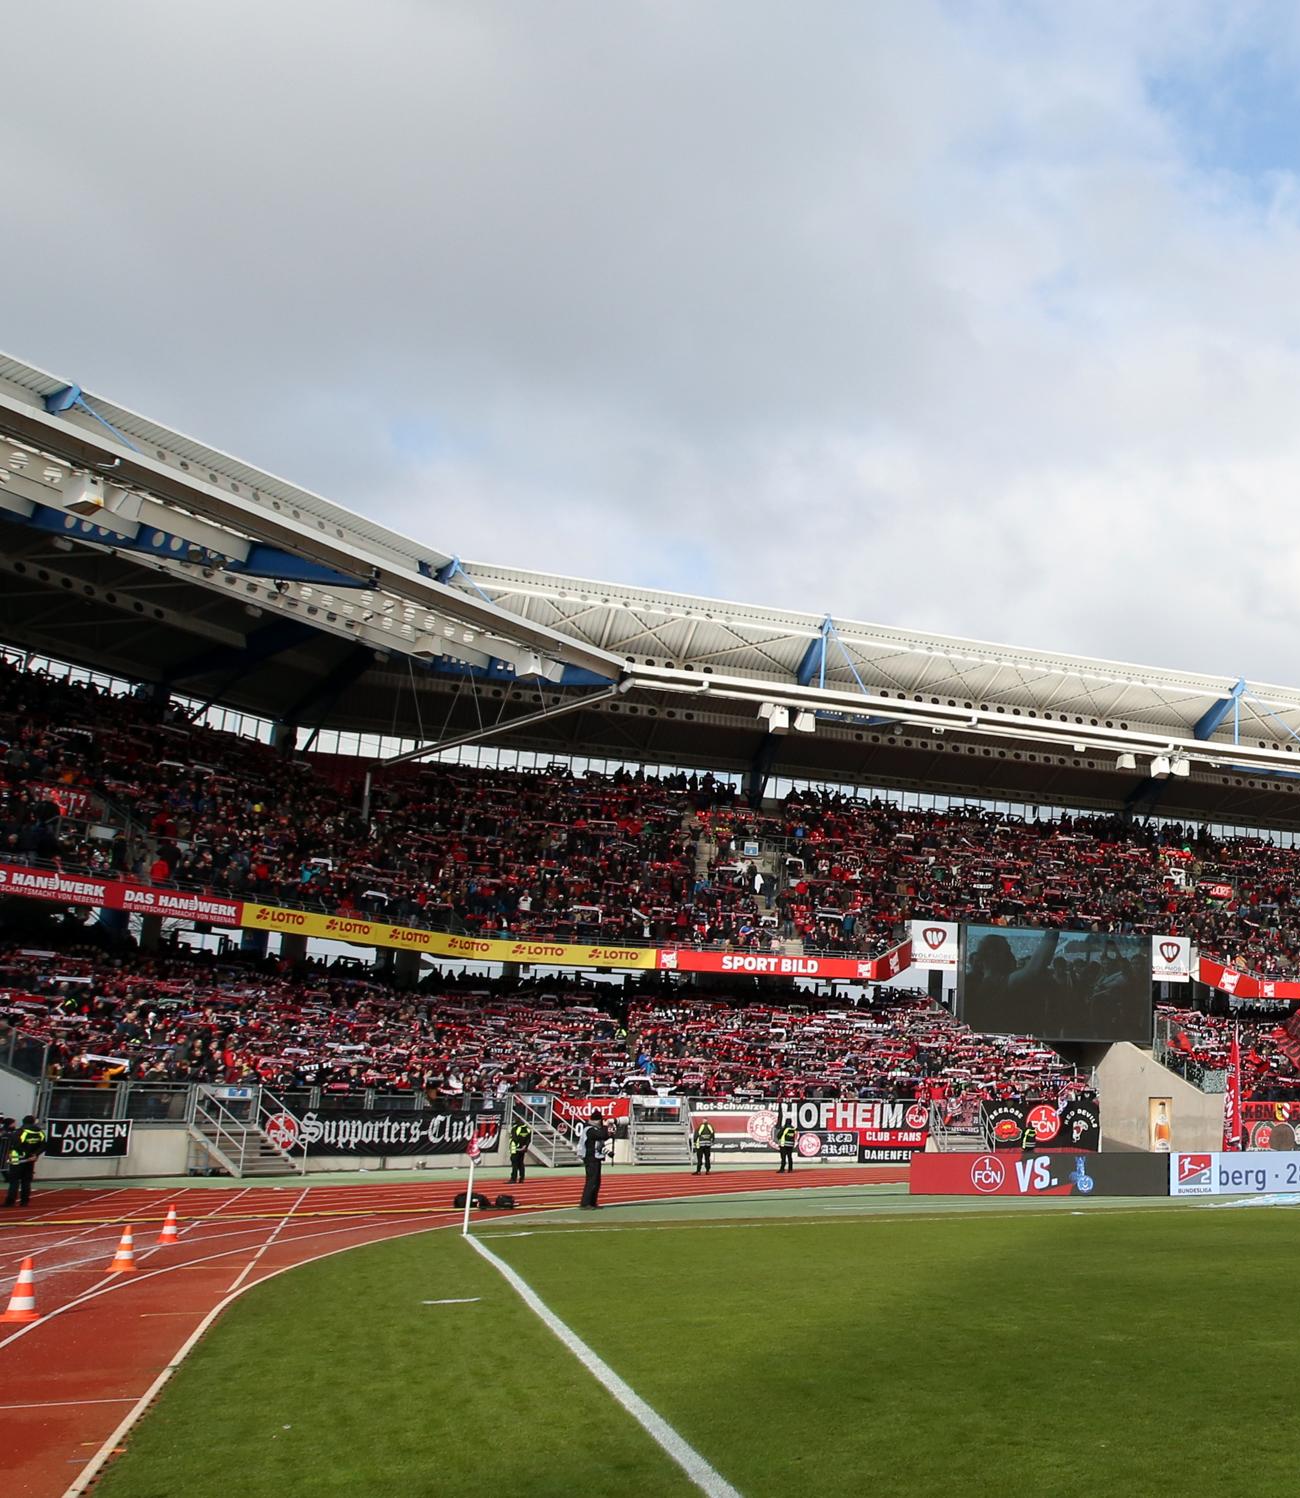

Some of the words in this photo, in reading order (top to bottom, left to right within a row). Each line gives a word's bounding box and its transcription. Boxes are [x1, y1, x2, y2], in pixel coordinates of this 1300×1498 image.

[124, 889, 155, 905] DAS
[158, 895, 237, 918] HANDWERK
[272, 912, 305, 926] LOTTO
[339, 921, 371, 935] LOTTO
[401, 931, 431, 944] LOTTO
[458, 940, 490, 952] LOTTO
[528, 945, 564, 957] LOTTO
[603, 950, 639, 961] LOTTO
[721, 955, 779, 972] SPORT
[780, 958, 819, 974] BILD
[781, 1102, 904, 1129] HOFHEIM
[51, 1123, 127, 1139] LANGEN
[298, 1111, 474, 1150] Supporters-Club
[866, 1131, 890, 1142] CLUB
[897, 1131, 922, 1142] FANS
[826, 1133, 853, 1143] RED
[61, 1139, 114, 1153] DORF
[821, 1144, 857, 1156] ARMY
[974, 1171, 1001, 1184] FCN
[1015, 1155, 1058, 1193] VS.
[1219, 1165, 1267, 1191] berg
